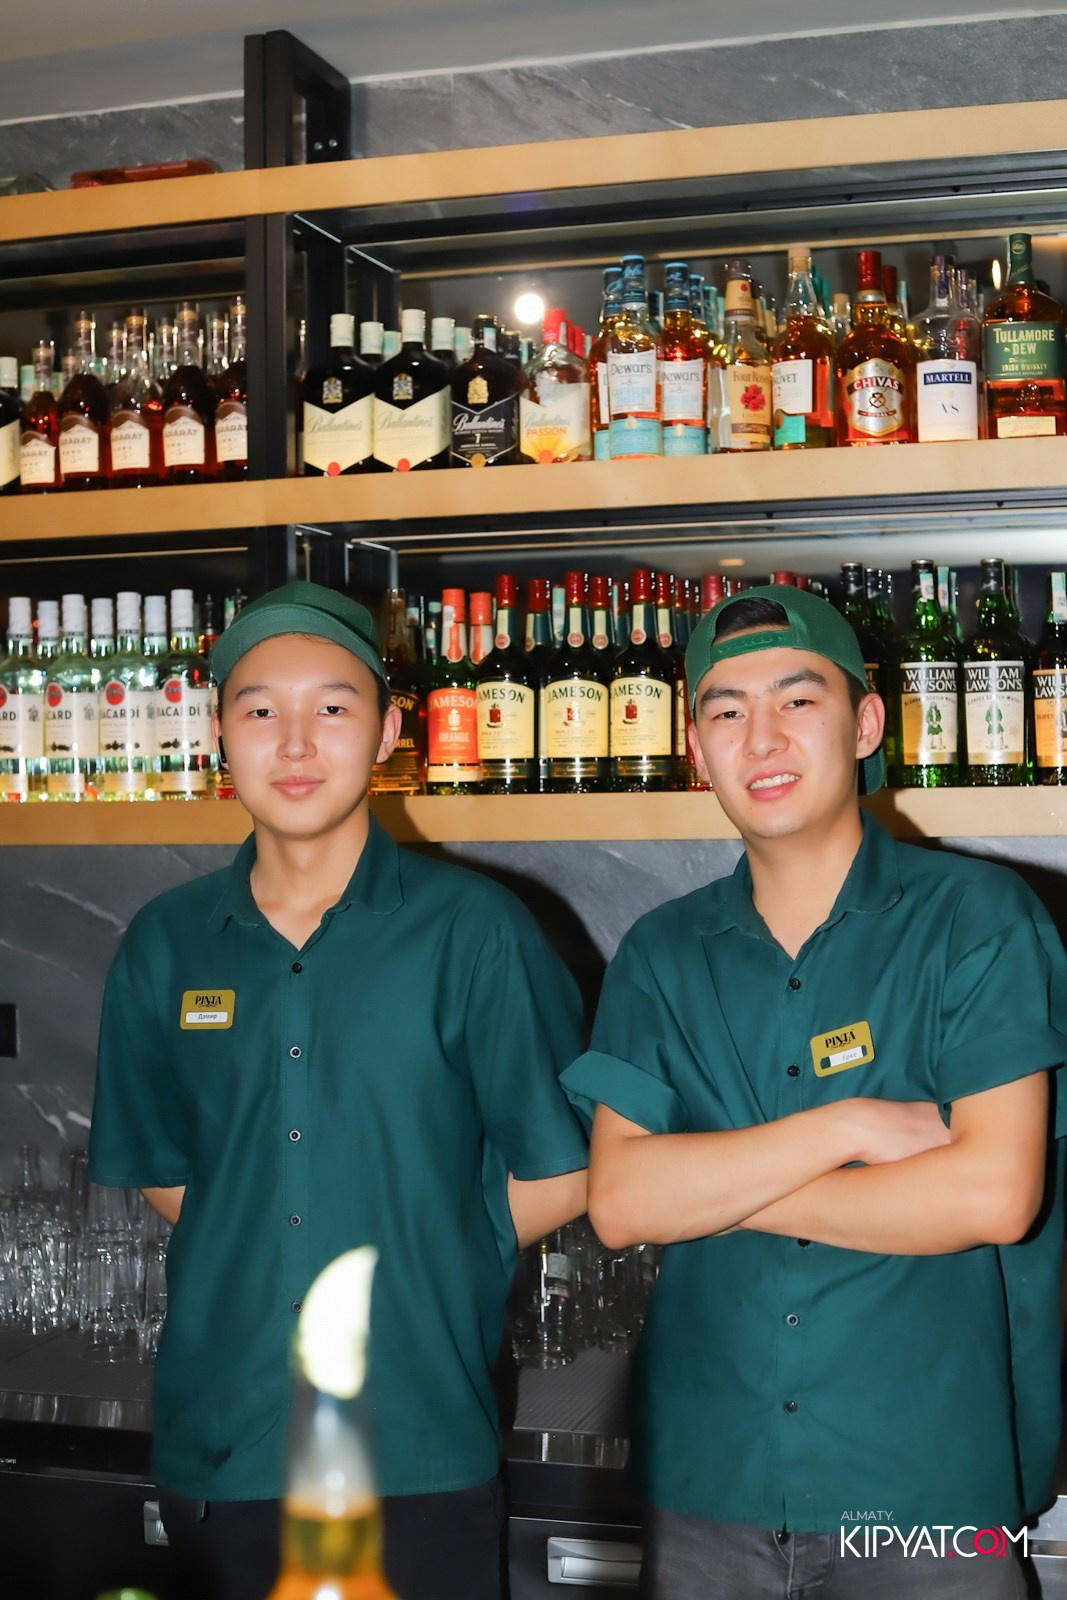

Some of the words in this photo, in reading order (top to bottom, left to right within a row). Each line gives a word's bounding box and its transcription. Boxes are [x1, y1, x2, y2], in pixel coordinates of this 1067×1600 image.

[993, 328, 1055, 343] TULLAMORE
[1012, 343, 1037, 355] DEW
[611, 363, 653, 375] Dewar's
[853, 376, 900, 391] CHIVAS
[925, 373, 971, 384] MARTELL
[453, 412, 506, 432] Ballantine's
[526, 426, 566, 436] PASSION
[905, 669, 955, 681] WILLIAM
[967, 667, 1019, 680] WILLIAM
[547, 686, 603, 704] JAMESON
[439, 732, 470, 743] ORANGE
[195, 995, 222, 1005] PINTA
[825, 1031, 856, 1048] PINTA
